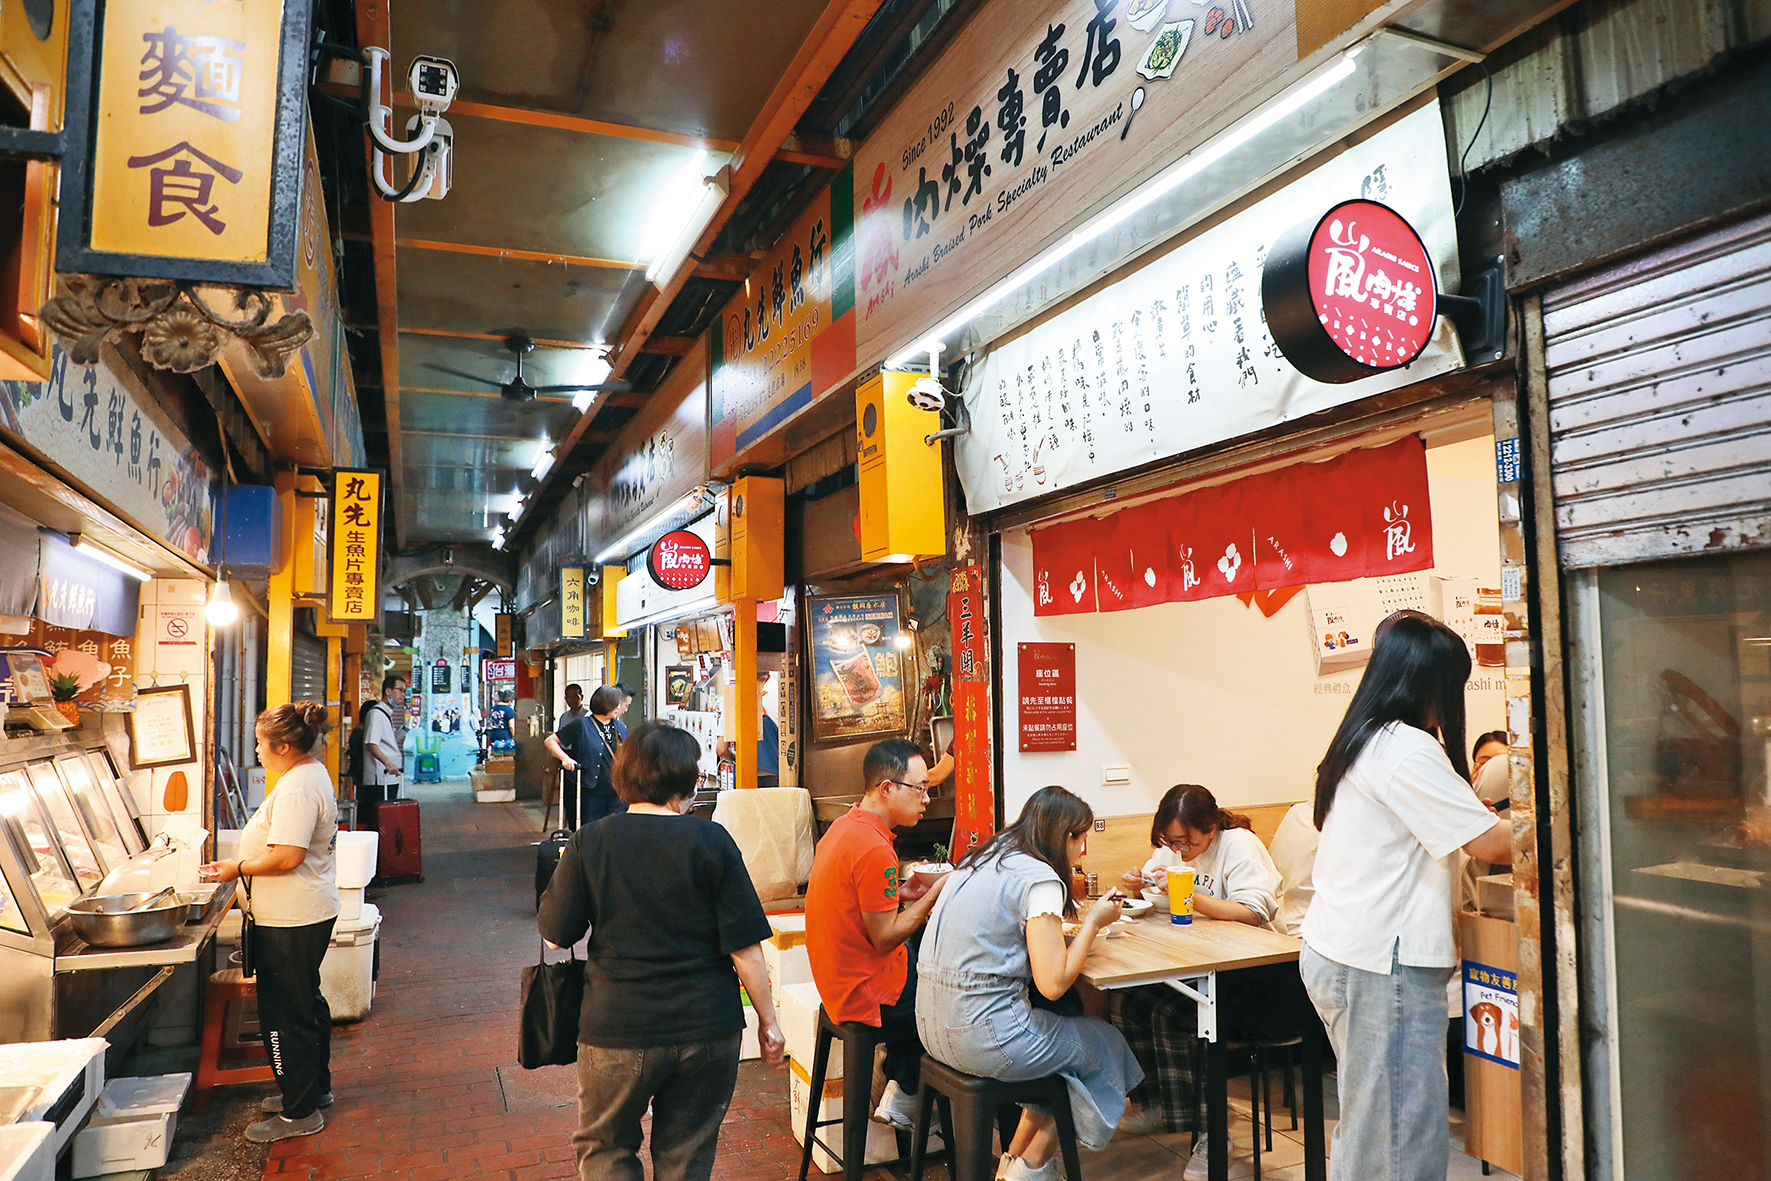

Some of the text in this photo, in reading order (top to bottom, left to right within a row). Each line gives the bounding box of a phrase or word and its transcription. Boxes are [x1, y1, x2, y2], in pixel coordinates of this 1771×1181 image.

[127, 26, 246, 236] 麵食
[902, 101, 956, 171] Since 1992
[903, 102, 1124, 289] Arashi Braised Pork Specialty Restaurant
[743, 217, 827, 357] 丸先鮮魚行
[1267, 535, 1294, 571] ARASHI
[1382, 500, 1416, 561] 嵐
[1037, 567, 1054, 607] 嵐
[1179, 543, 1201, 591] 嵐
[959, 596, 974, 682] 三羊開
[884, 866, 897, 897] 3
[1480, 991, 1493, 1000] Pet
[269, 1030, 284, 1076] RUNNING
